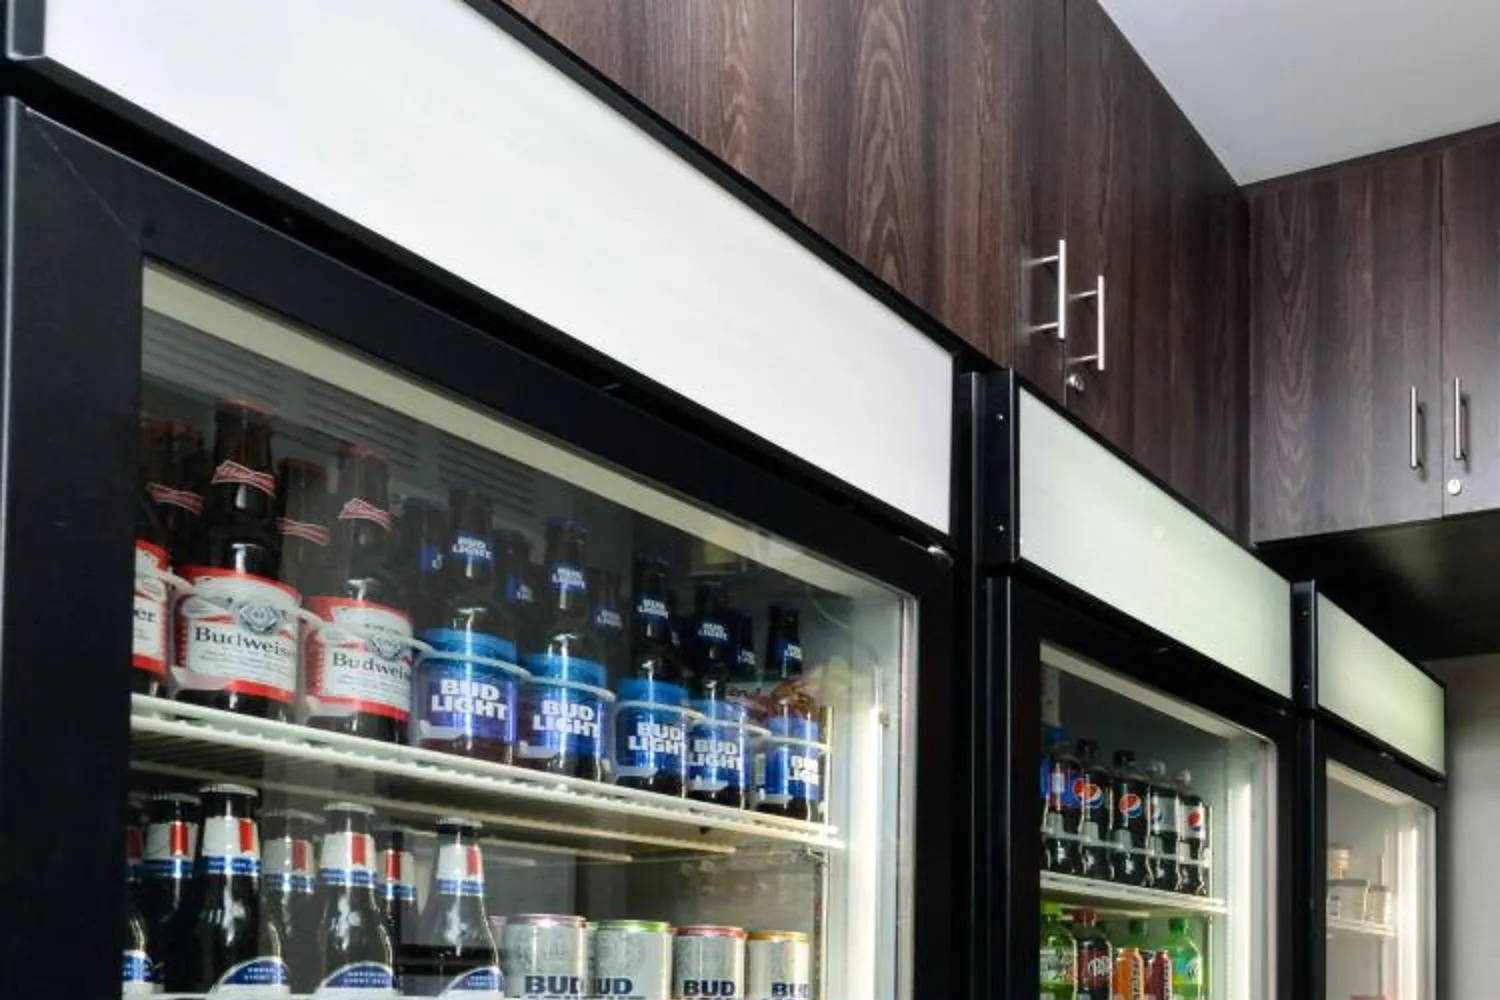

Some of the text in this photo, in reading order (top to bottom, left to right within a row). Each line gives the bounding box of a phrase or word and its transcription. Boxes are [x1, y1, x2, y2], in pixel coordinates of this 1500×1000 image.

[441, 679, 500, 701] BUD
[432, 695, 508, 720] LIGHT
[542, 700, 594, 720] BUD
[533, 715, 601, 739] LIGHT
[637, 721, 683, 740] BUD
[694, 739, 737, 754] BUD
[525, 976, 584, 995] BUD
[683, 980, 735, 996] BUD
